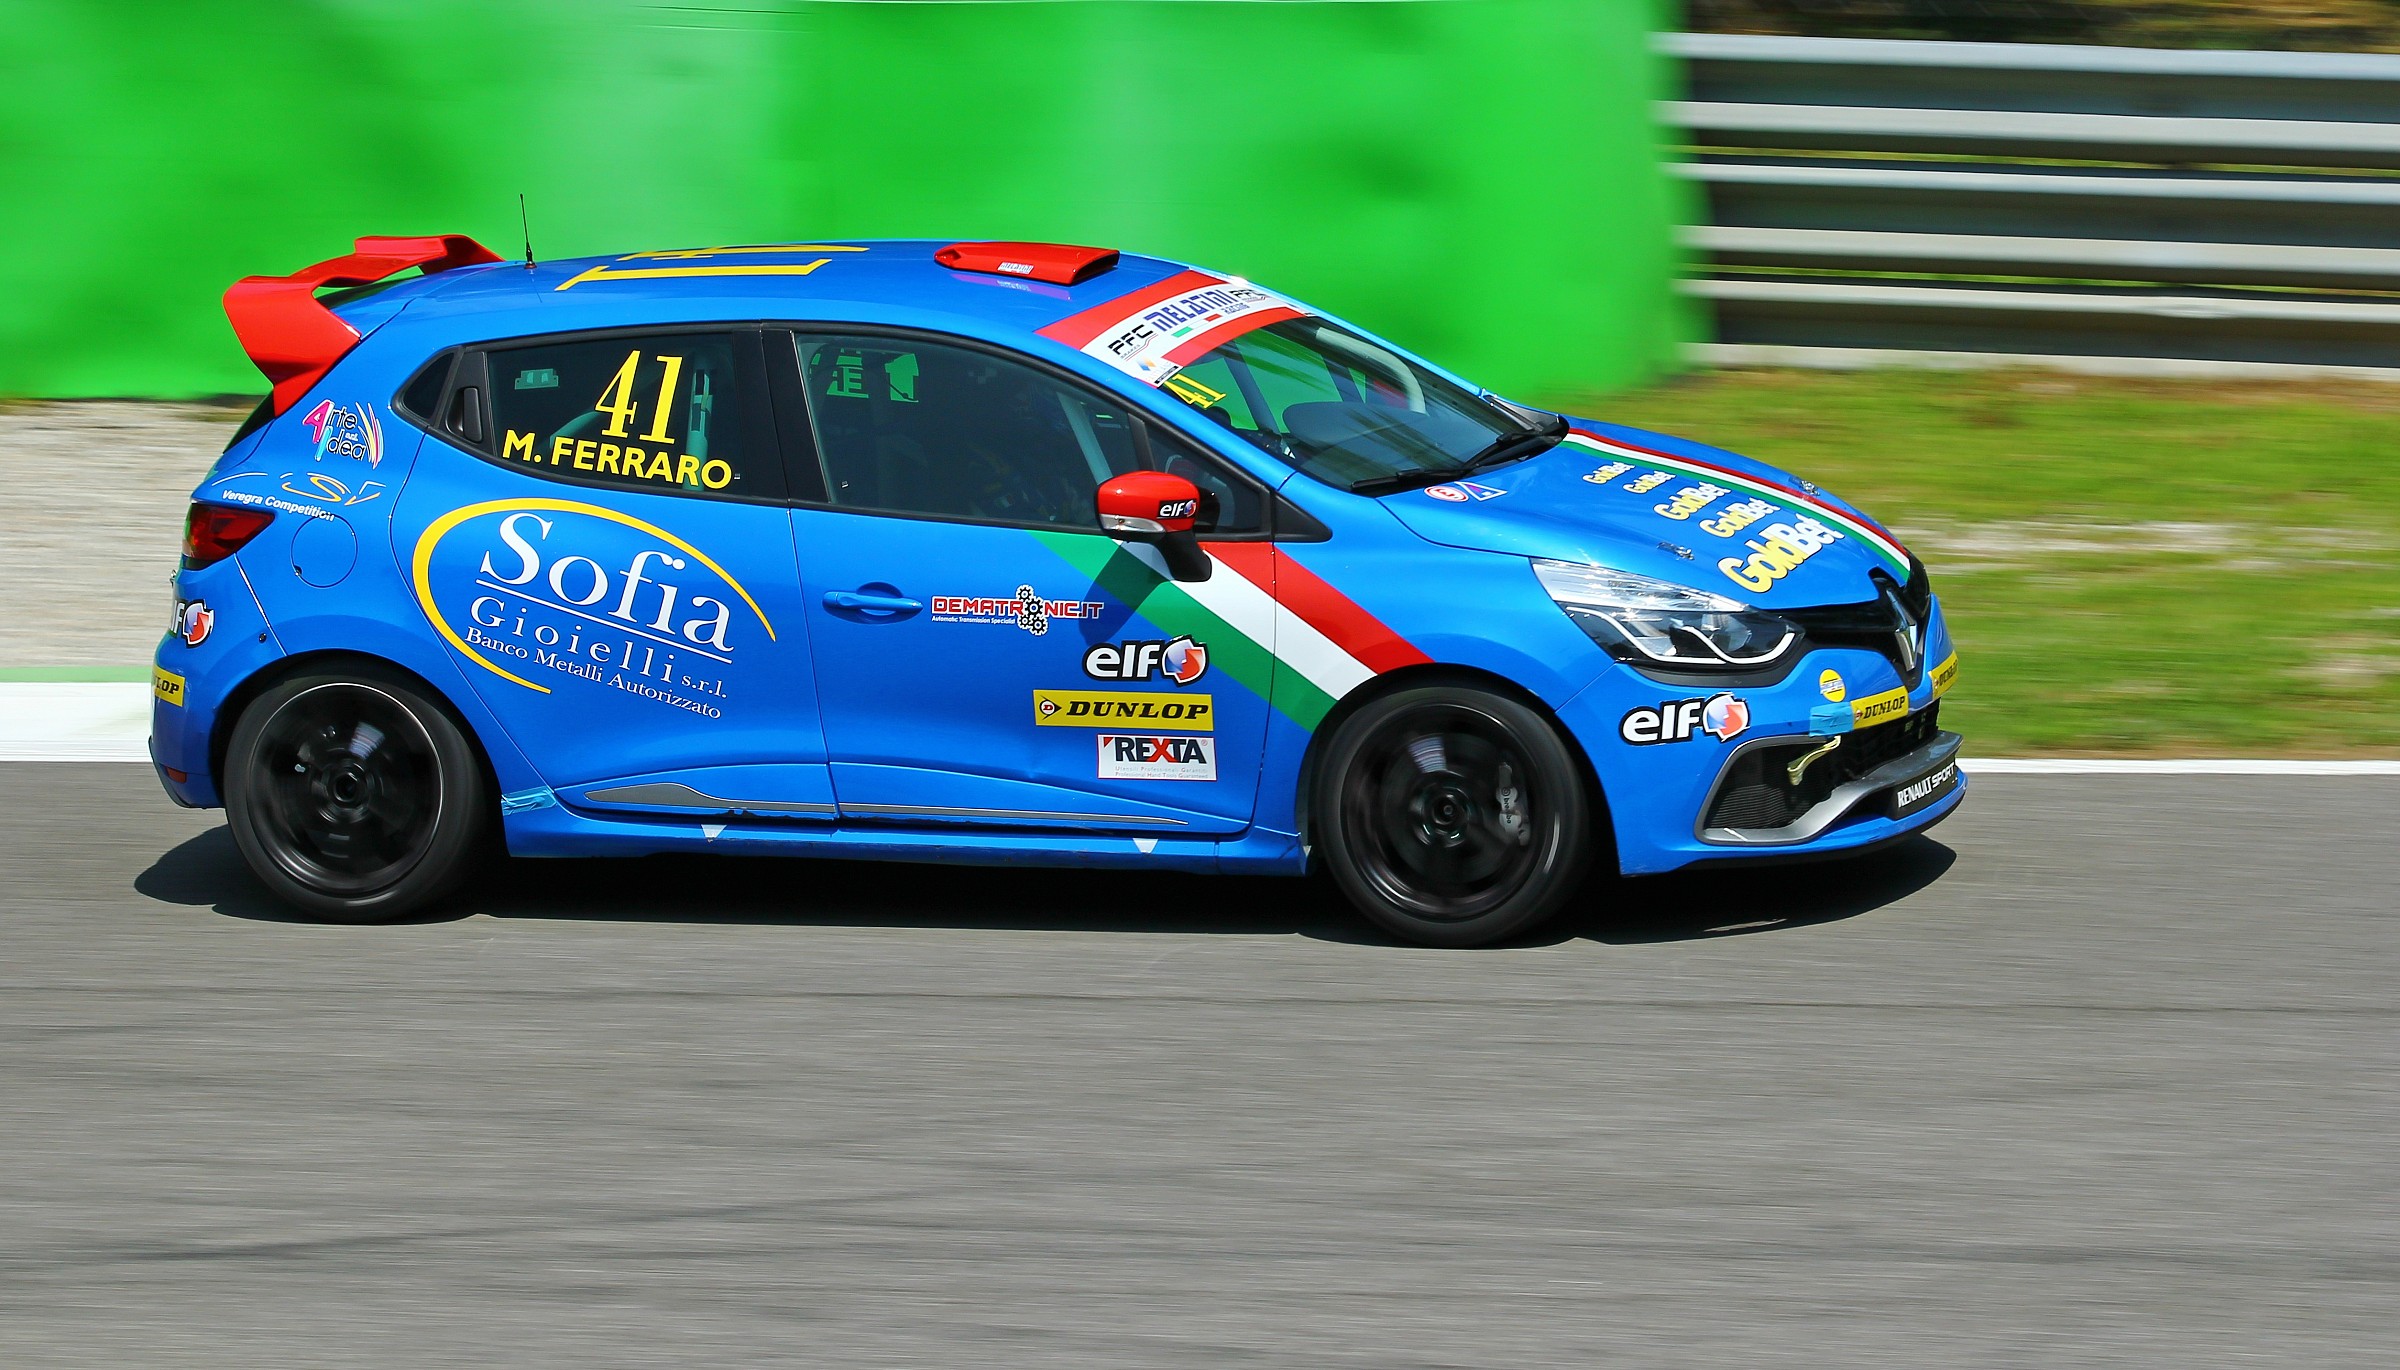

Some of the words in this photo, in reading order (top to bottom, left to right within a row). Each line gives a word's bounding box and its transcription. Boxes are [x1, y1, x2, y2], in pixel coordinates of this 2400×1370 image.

[1107, 324, 1154, 355] PFC
[594, 350, 683, 445] 41
[1163, 373, 1227, 410] 41
[502, 429, 542, 463] M.
[550, 436, 732, 489] FERRARO
[1582, 461, 1636, 484] GoldBet
[1622, 470, 1677, 494] GoldBet
[222, 489, 263, 504] Veregra
[264, 496, 335, 521] Competition
[1160, 502, 1185, 517] elf
[1653, 481, 1733, 521] GoldBet
[1699, 496, 1782, 538] GoldBet
[1716, 512, 1846, 593] GoldBet
[480, 512, 735, 653] Sofia
[959, 616, 991, 624] Transmission
[470, 596, 675, 683] Gioielli
[681, 673, 728, 698] s.r.l.
[1086, 643, 1161, 678] elf
[465, 626, 529, 660] Banco
[533, 648, 604, 682] Metalli
[607, 673, 722, 720] Autorizzato
[1066, 700, 1209, 720] DUNLOP
[1622, 701, 1701, 742] elf
[1863, 695, 1906, 719] DUNLOP
[1114, 736, 1208, 764] REXTA
[1897, 775, 1933, 808] RENAULT
[1931, 761, 1955, 789] SPORT
